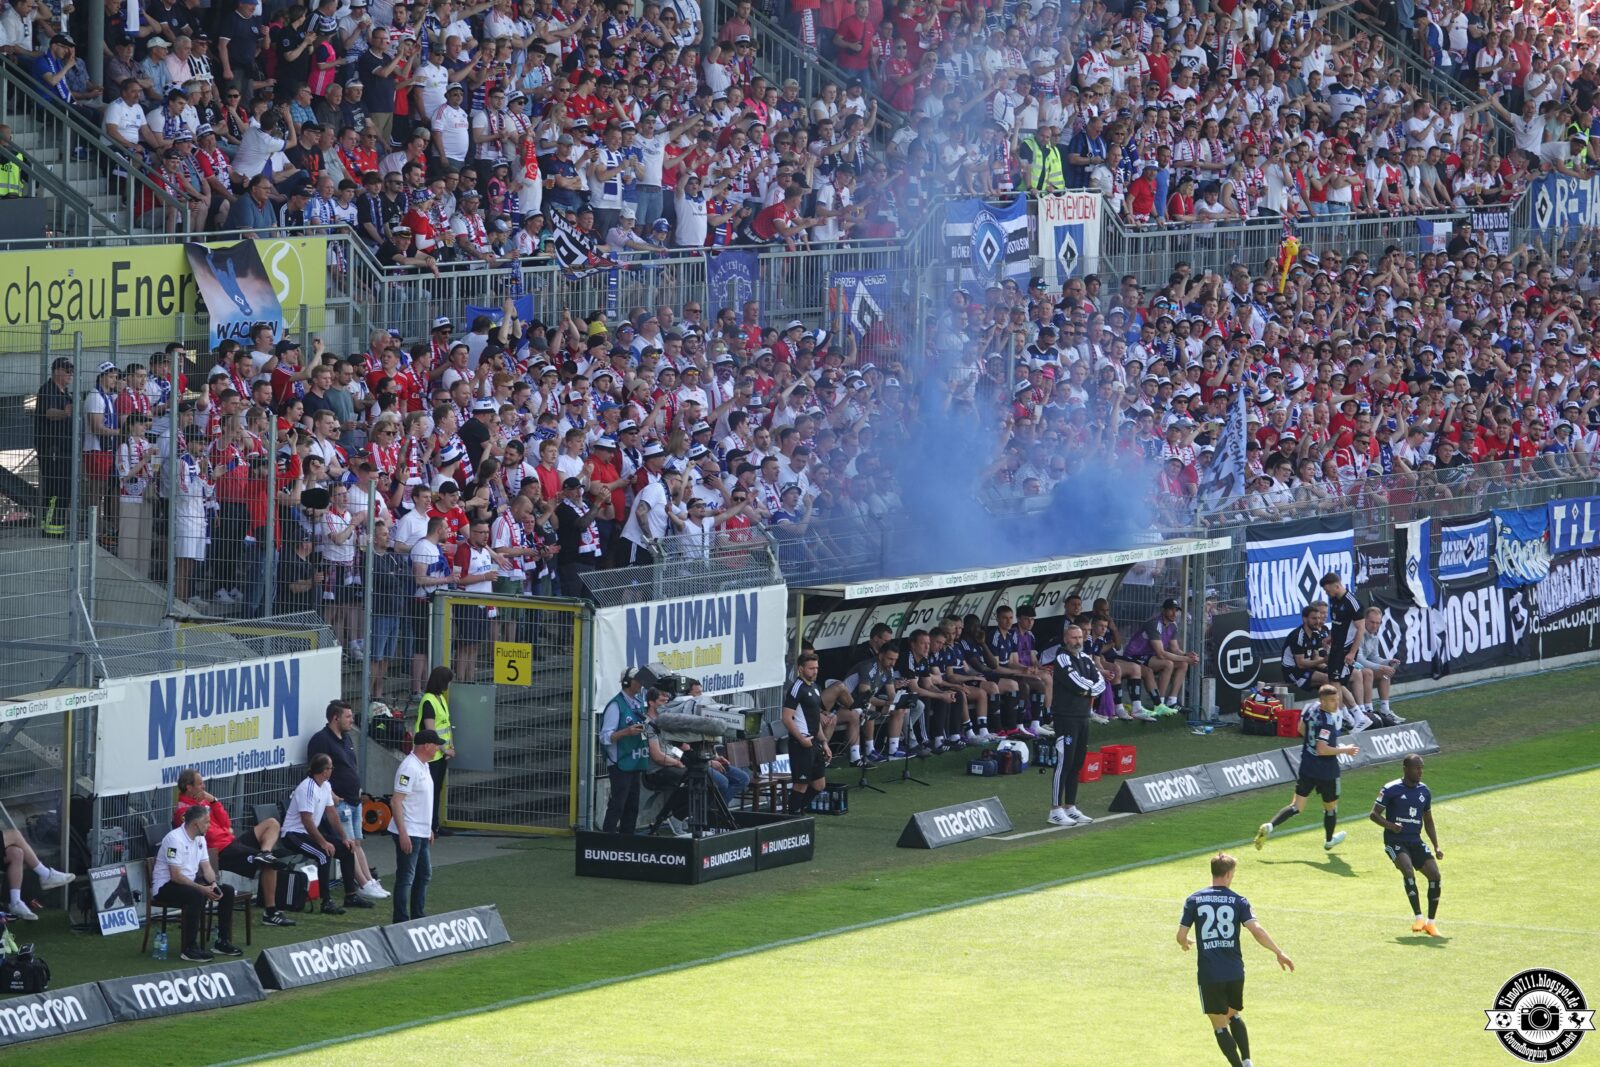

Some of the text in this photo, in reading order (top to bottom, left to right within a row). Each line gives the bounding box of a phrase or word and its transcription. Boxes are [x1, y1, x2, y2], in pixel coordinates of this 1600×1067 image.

[1472, 212, 1508, 230] HAMBURG
[216, 320, 278, 339] WACN
[626, 592, 758, 667] NAUMANN
[886, 608, 934, 631] capro
[496, 648, 531, 660] Fluchttür
[657, 643, 722, 671] Tiefbau GmbH
[1227, 647, 1253, 675] GP
[506, 659, 519, 682] 5
[5, 701, 49, 717] cafpro GmbH
[65, 690, 108, 706] cafpro GmbH
[148, 658, 300, 760] NAUMANN
[184, 716, 259, 750] Tiefbau GmbH
[1370, 729, 1425, 757] macron
[162, 745, 285, 784] wwwnaumann-tiefbau.de
[1222, 758, 1279, 788] macron
[1144, 773, 1201, 804] macron
[933, 806, 995, 838] macron
[710, 846, 752, 868] BUNDESLIGA
[768, 833, 810, 853] BUNDESLIGA
[584, 849, 686, 866] BUNDESLIGA.COM
[407, 915, 488, 953] macron
[1197, 904, 1235, 940] 28
[289, 938, 372, 977] macron
[132, 971, 236, 1010] macron
[0, 995, 87, 1036] macron
